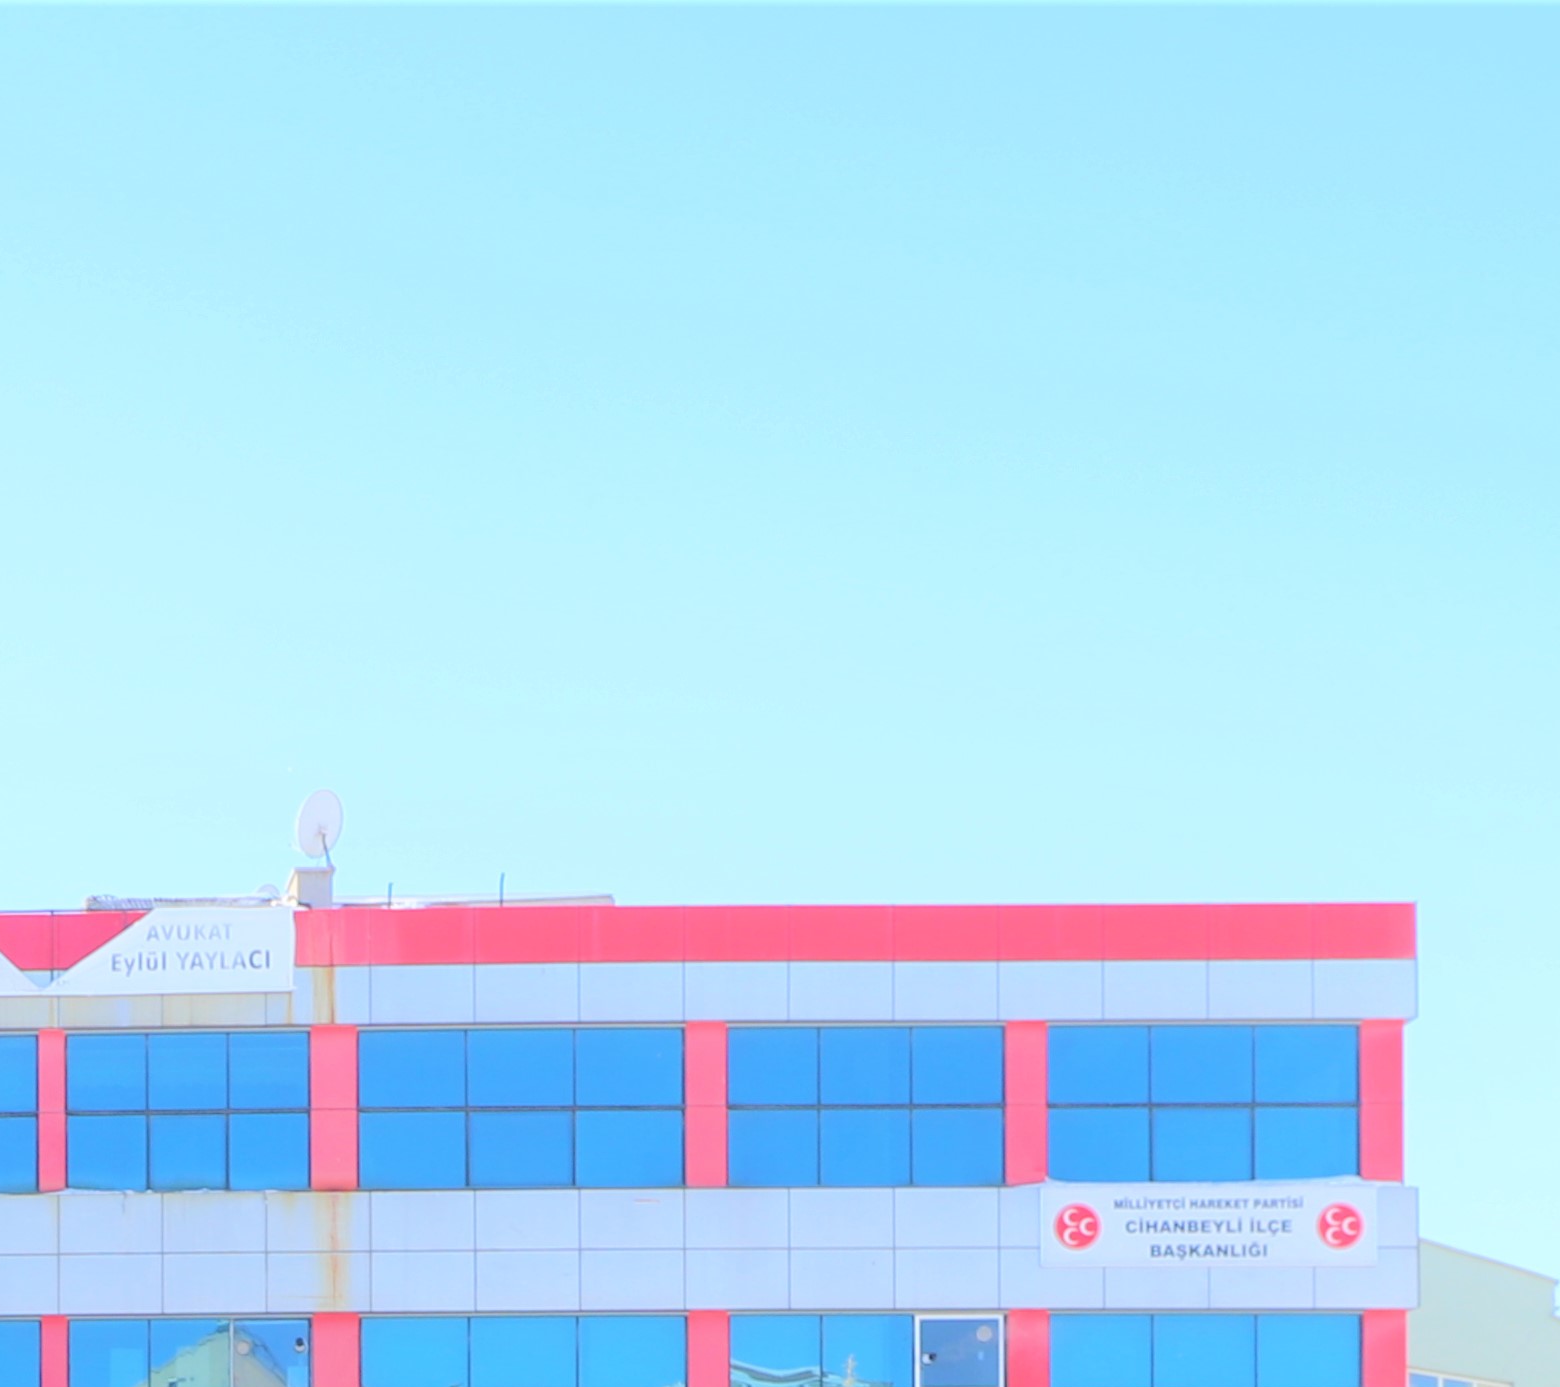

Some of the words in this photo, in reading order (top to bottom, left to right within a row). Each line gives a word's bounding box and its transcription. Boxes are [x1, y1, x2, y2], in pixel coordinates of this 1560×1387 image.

[146, 923, 232, 942] AVUKAT
[111, 951, 167, 977] Eylül
[176, 950, 271, 971] YAYLACI
[1113, 1197, 1186, 1210] MİLLİYETÇİ
[1189, 1198, 1249, 1209] HAREKET
[1253, 1196, 1304, 1209] PARTİSİ
[1125, 1217, 1243, 1234] CİHANBEYLİ
[1249, 1216, 1292, 1236] İLÇE
[1149, 1242, 1268, 1261] BAŞKANLIĞI
